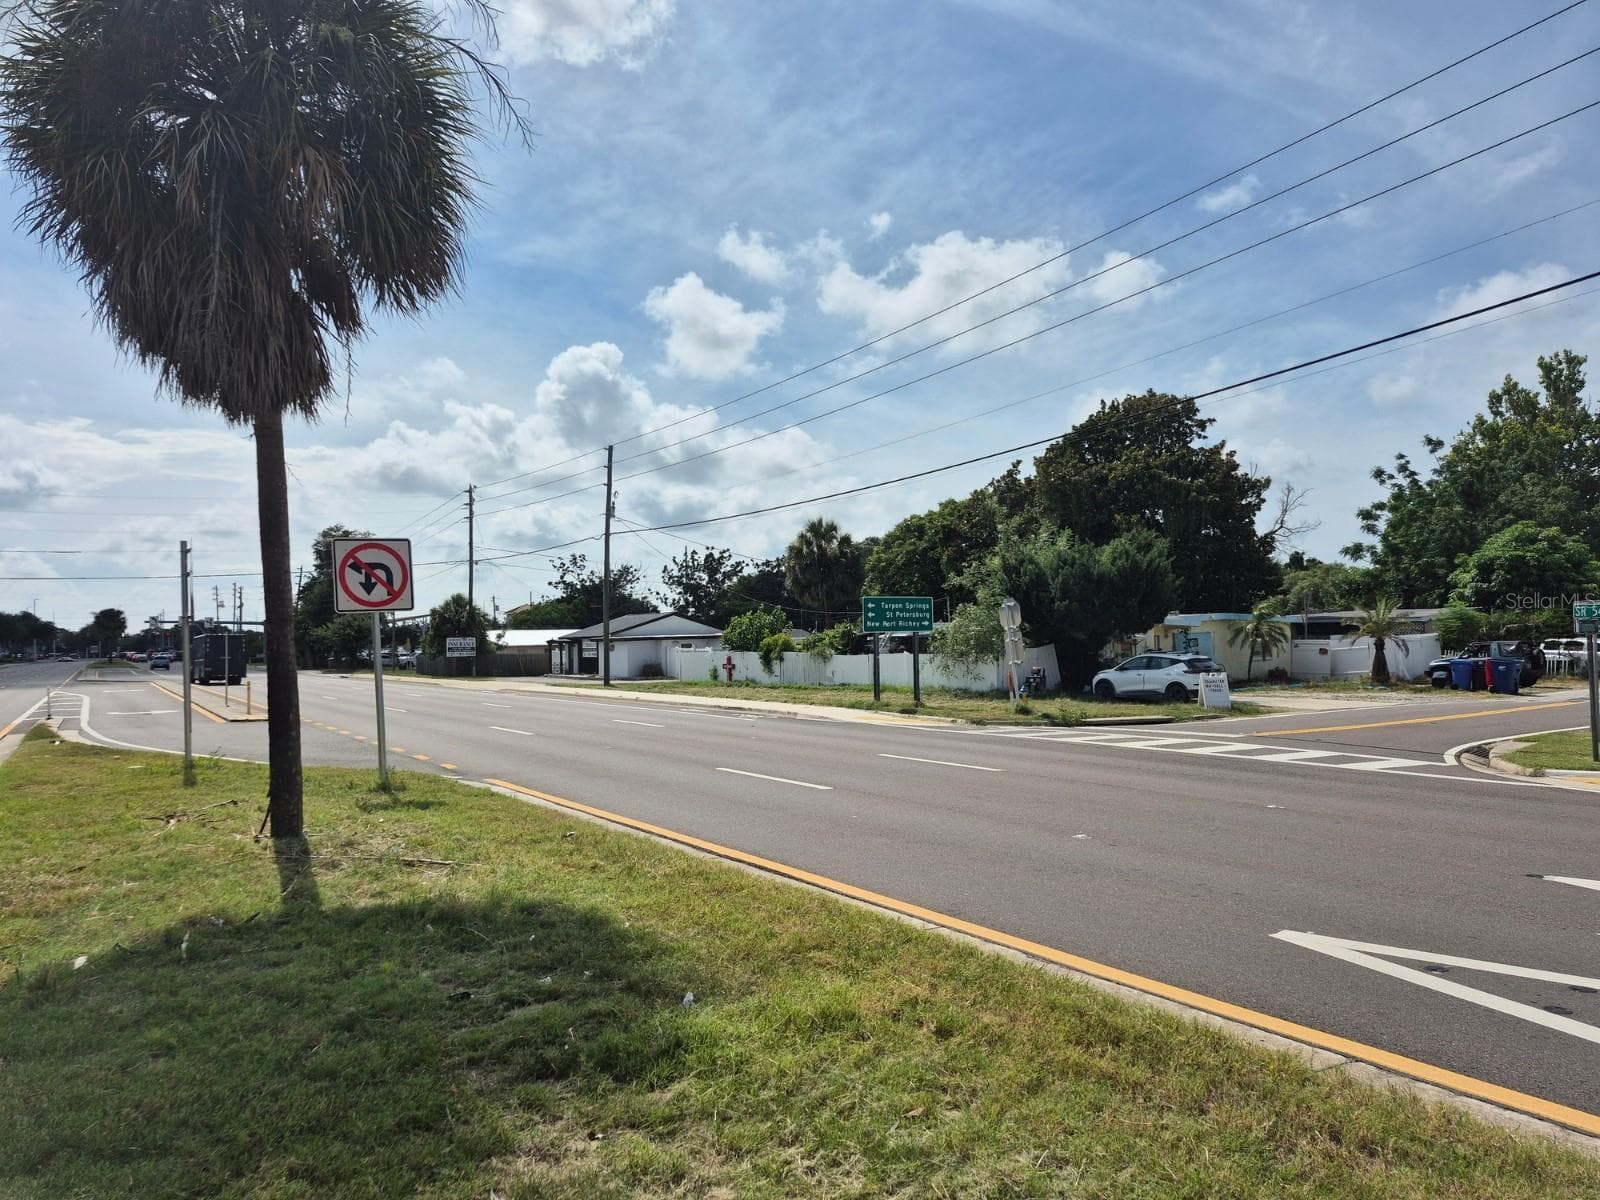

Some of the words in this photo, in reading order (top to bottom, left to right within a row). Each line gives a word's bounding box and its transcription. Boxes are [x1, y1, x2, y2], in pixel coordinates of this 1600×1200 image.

[881, 602, 903, 610] Tarpon
[905, 602, 930, 610] Springs
[895, 611, 930, 619] Petersburg
[1575, 605, 1587, 617] SR
